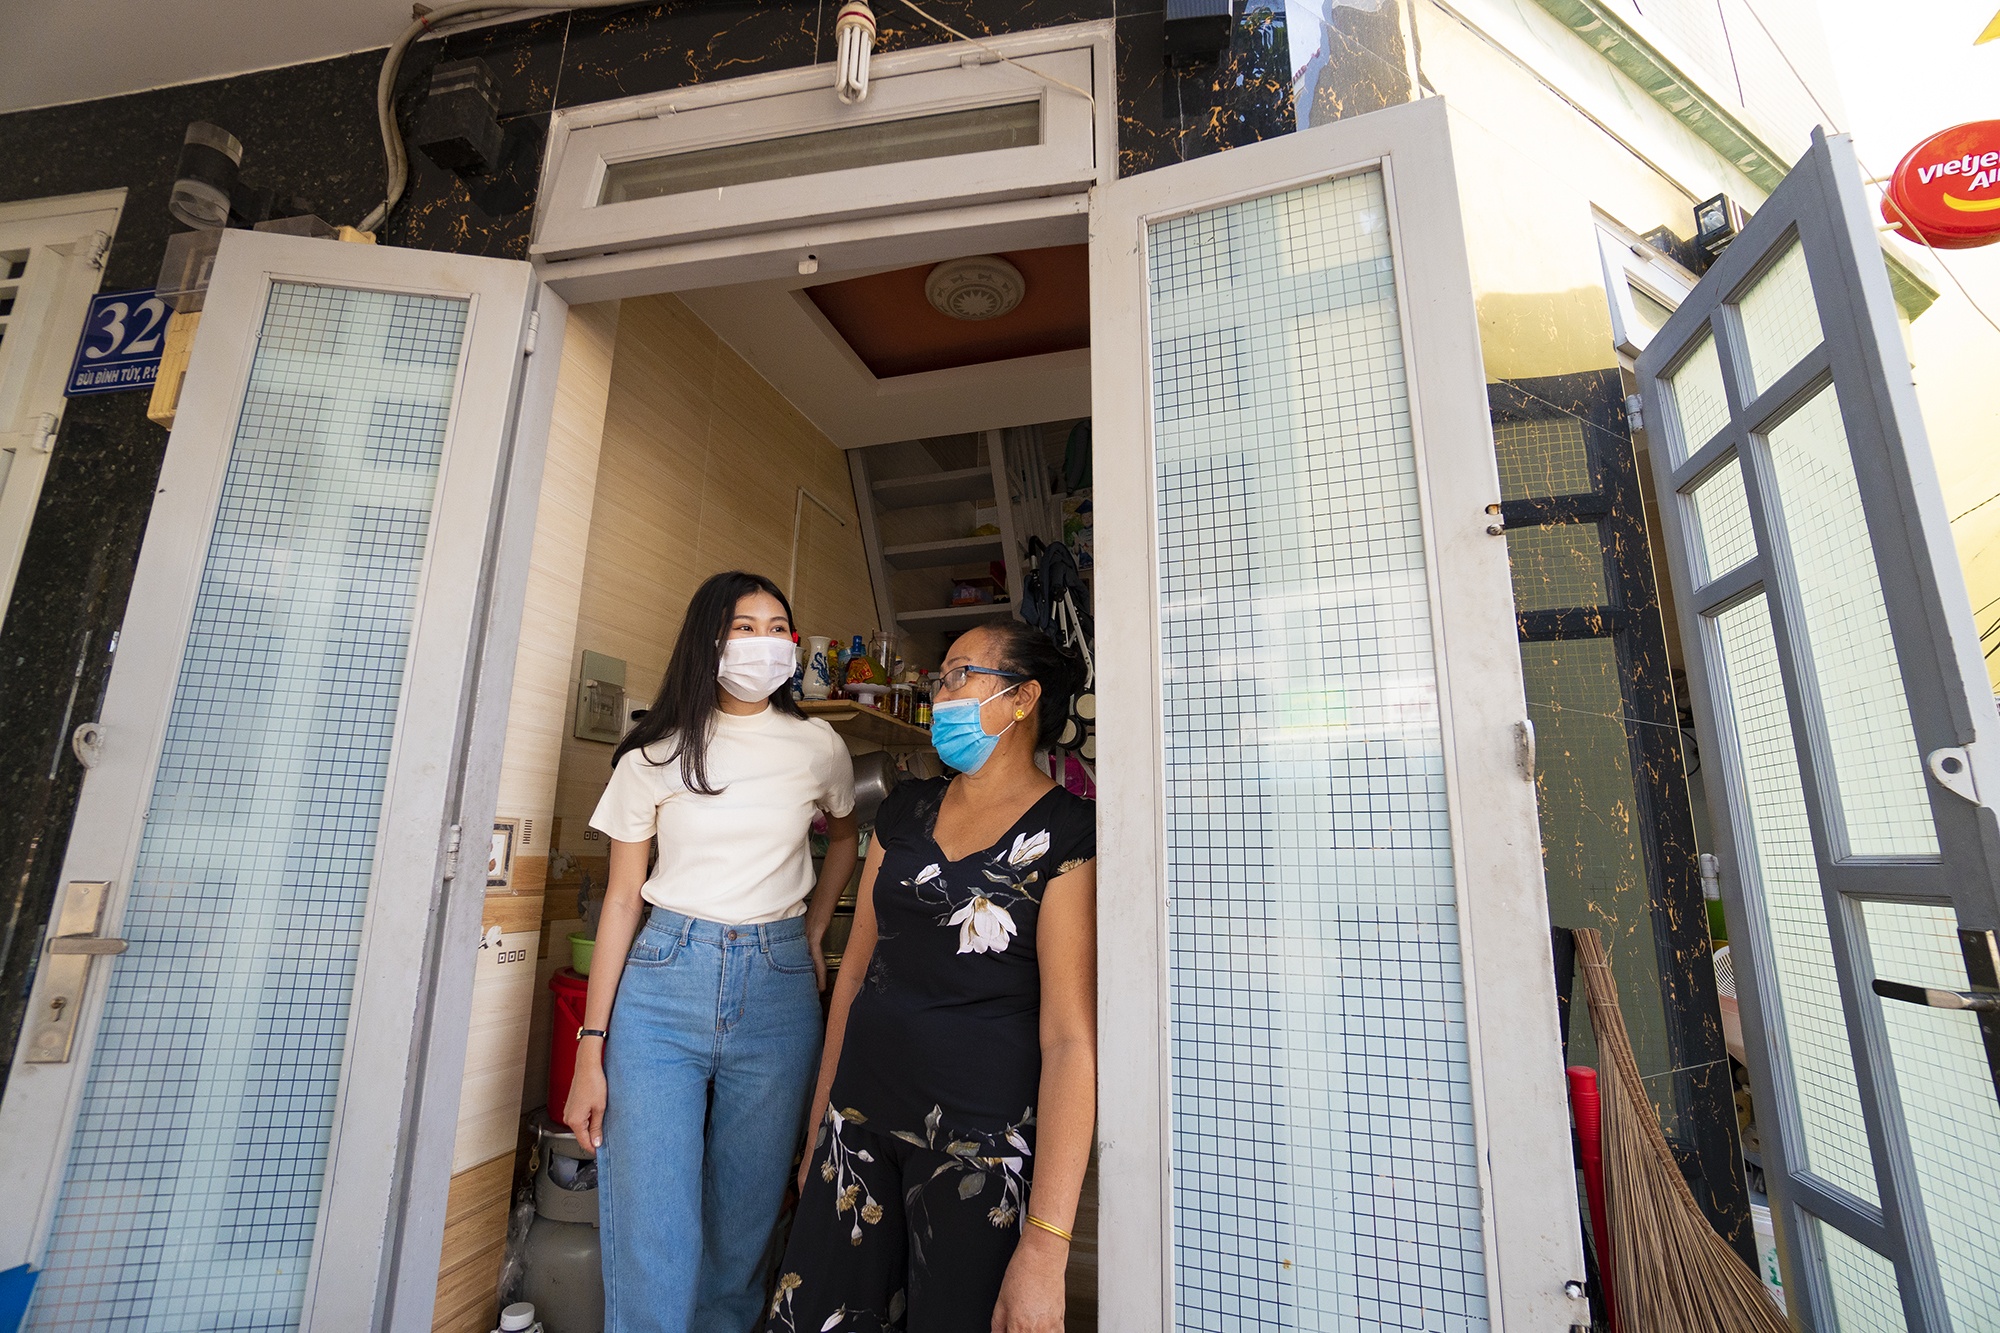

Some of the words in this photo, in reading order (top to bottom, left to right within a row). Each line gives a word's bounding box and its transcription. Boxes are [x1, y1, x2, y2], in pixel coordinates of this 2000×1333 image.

[1917, 150, 2000, 185] Vietje
[85, 298, 174, 359] 32
[76, 369, 95, 386] BÙI
[95, 368, 120, 384] ĐÌNH
